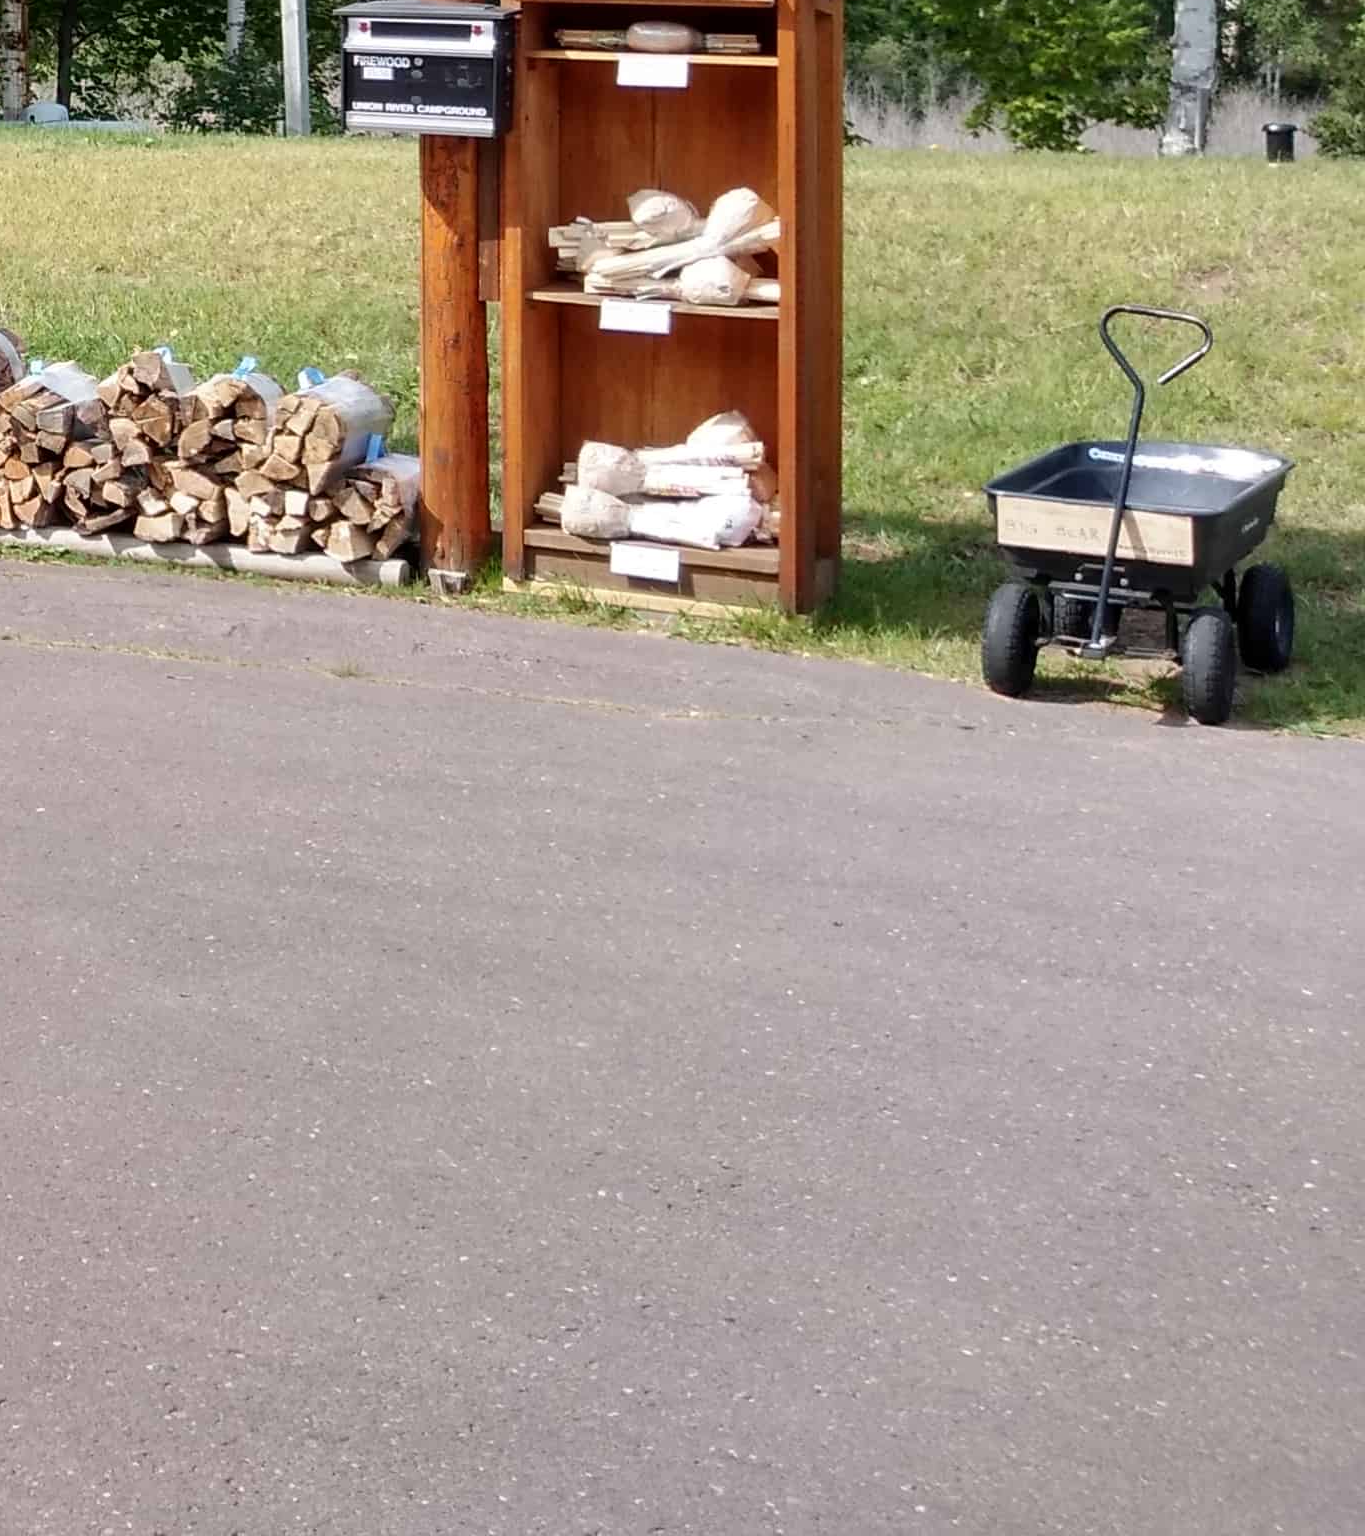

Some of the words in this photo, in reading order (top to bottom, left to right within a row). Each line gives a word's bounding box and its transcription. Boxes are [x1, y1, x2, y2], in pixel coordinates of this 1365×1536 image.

[353, 55, 411, 68] FIREWOOD
[352, 101, 383, 111] UNION
[385, 103, 414, 113] RIVER
[416, 104, 487, 116] CAMPGROUND
